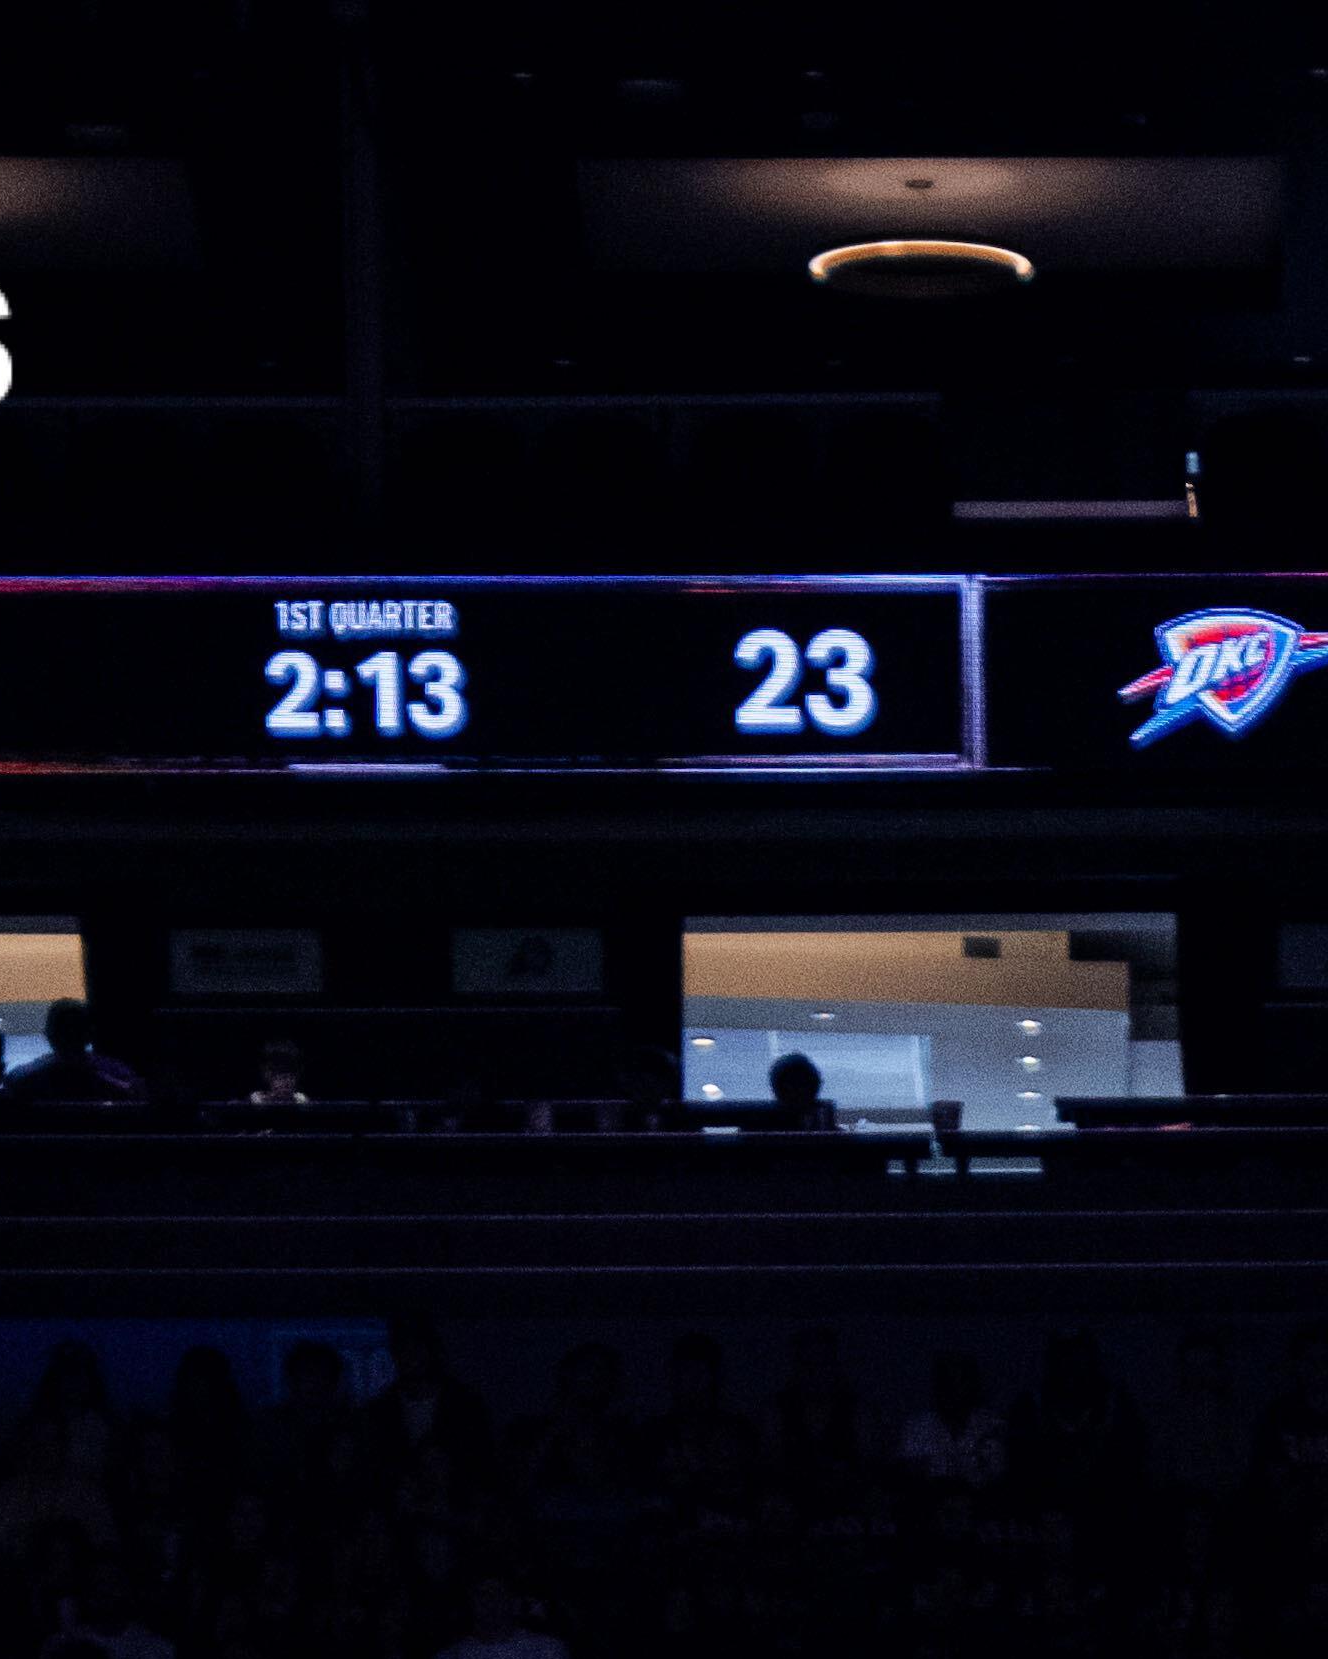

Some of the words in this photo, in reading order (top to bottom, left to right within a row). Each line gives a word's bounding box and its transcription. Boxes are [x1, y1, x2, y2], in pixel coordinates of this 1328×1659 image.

[276, 601, 323, 632] 1ST
[331, 601, 454, 632] QUARTER
[265, 650, 466, 737] 2:13
[734, 628, 876, 734] 23
